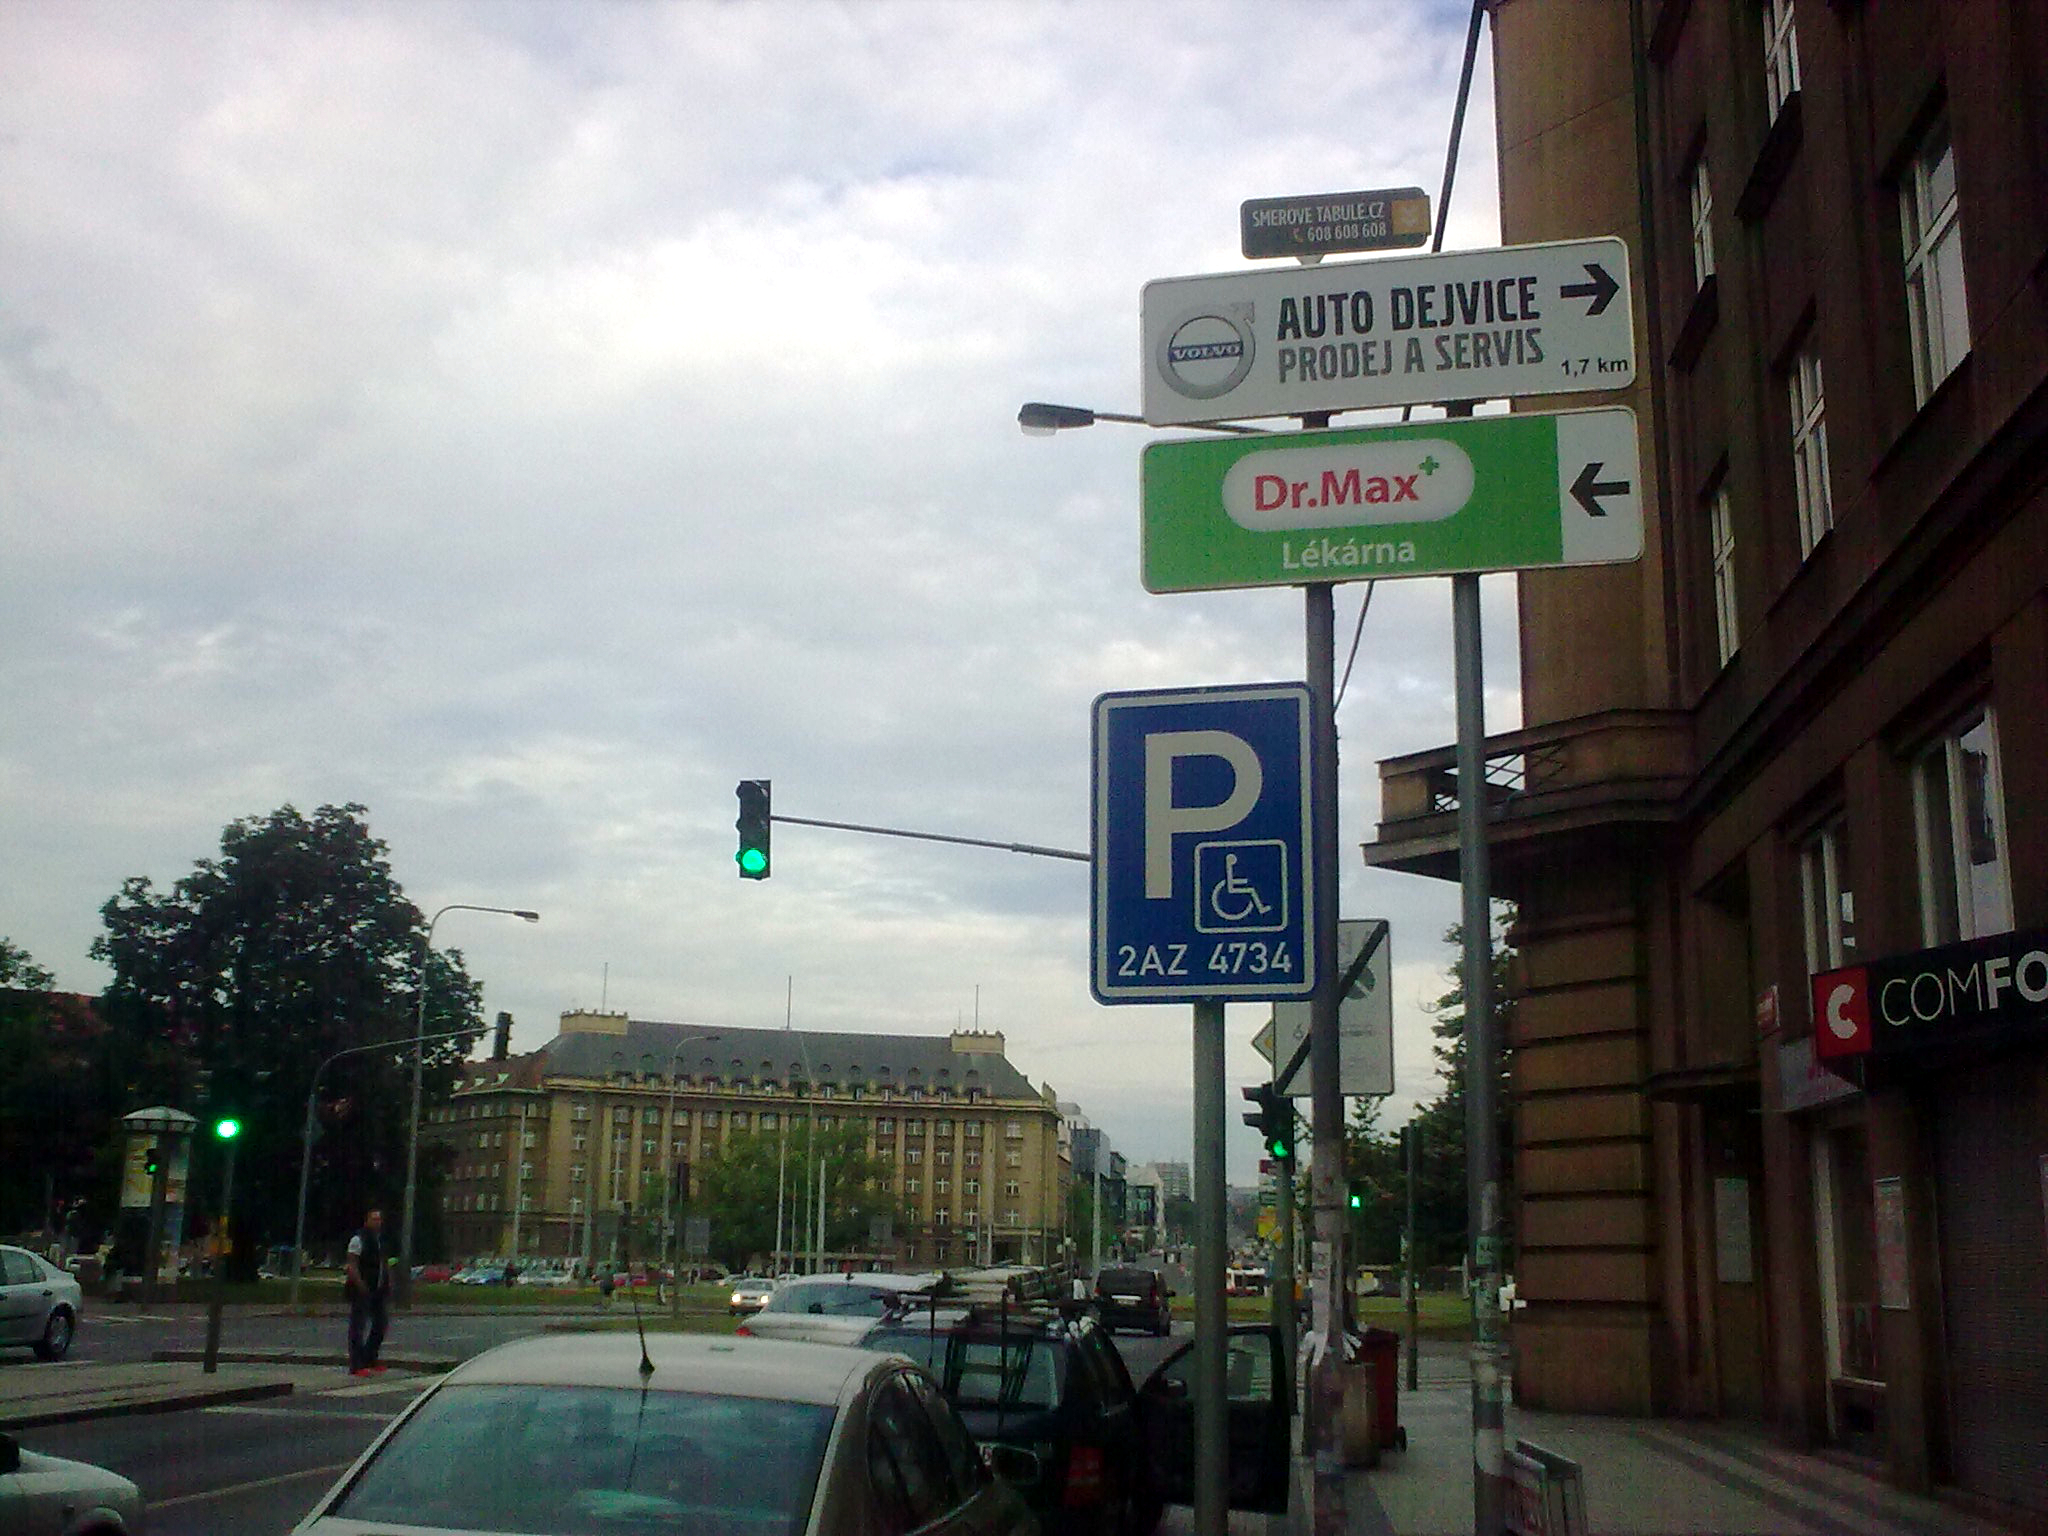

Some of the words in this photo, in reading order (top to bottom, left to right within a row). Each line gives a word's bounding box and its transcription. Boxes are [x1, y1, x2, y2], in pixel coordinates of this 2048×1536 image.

[1307, 226, 1332, 242] 608
[1335, 224, 1359, 240] 608
[1362, 223, 1387, 238] 608
[1277, 290, 1374, 341] AUTO
[1391, 276, 1541, 331] DEJVICE
[1173, 344, 1241, 359] VOLVO
[1278, 339, 1392, 384] PRODEJ
[1403, 336, 1426, 374] A
[1435, 328, 1545, 371] SERVIS
[1561, 358, 1590, 378] 1,7
[1598, 357, 1629, 374] km
[1282, 538, 1416, 570] Lékárna
[1145, 729, 1263, 899] P
[1118, 943, 1189, 977] 2AZ
[1208, 941, 1292, 975] 4734
[1881, 950, 2048, 1026] COMFO
